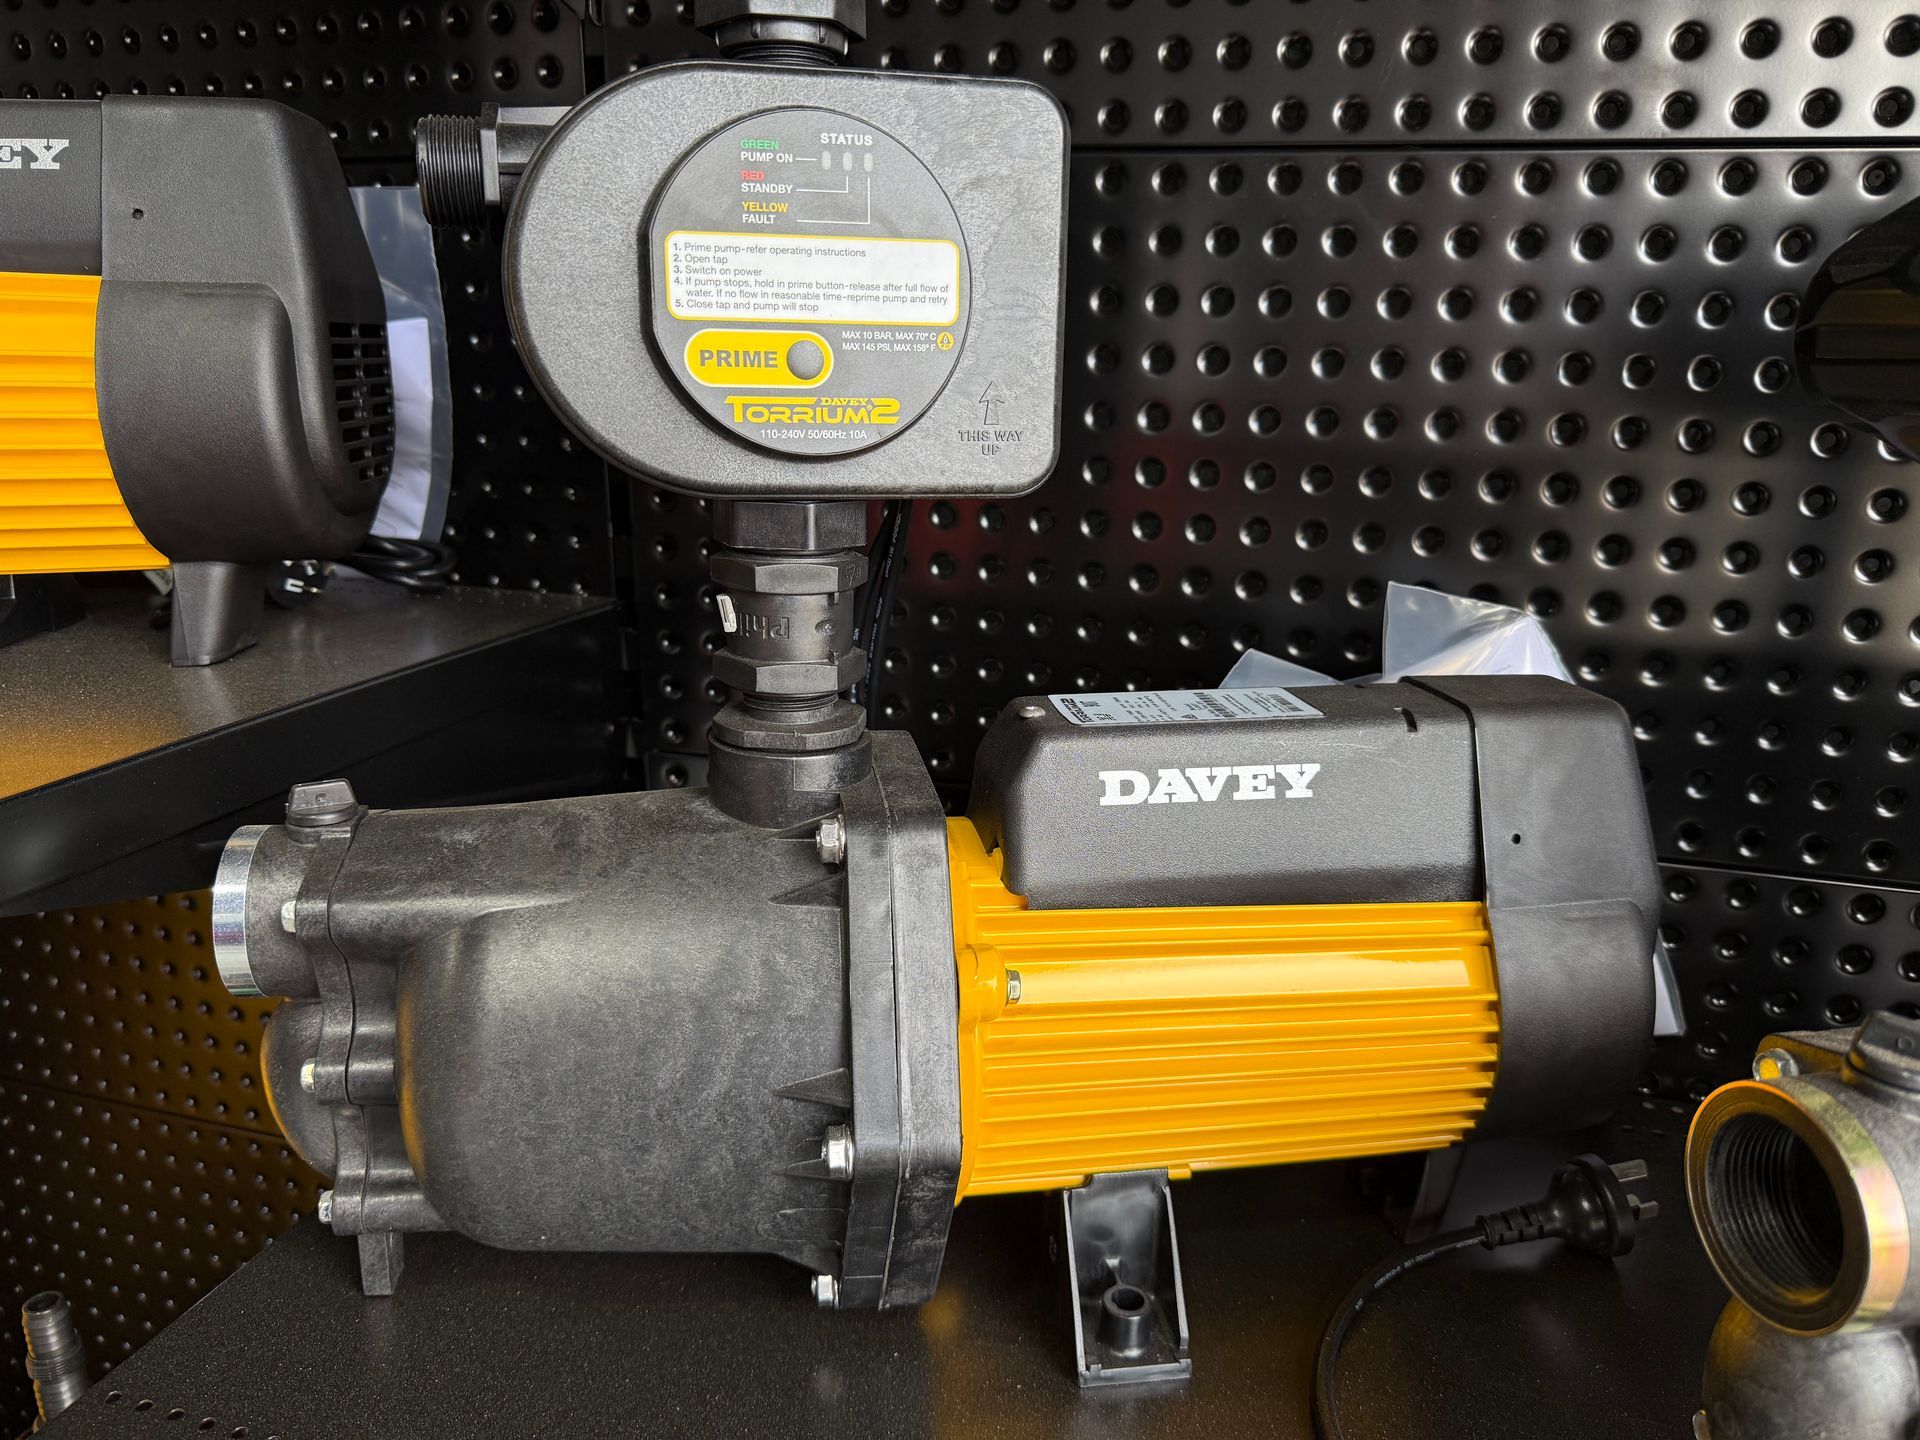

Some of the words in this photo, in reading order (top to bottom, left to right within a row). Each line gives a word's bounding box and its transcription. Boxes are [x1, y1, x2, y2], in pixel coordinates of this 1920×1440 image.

[740, 138, 779, 150] GREEN
[820, 132, 873, 146] STATUS
[740, 151, 774, 162] PUMP
[776, 153, 793, 163] ON
[741, 170, 765, 181] RED
[741, 183, 793, 194] STANDBY
[742, 201, 788, 213] YELLOW
[742, 214, 776, 224] FAULT
[673, 243, 681, 251] 1.
[684, 242, 711, 252] Prime
[714, 244, 767, 254] pump-refer
[769, 246, 812, 257] operating
[815, 247, 866, 258] instructions
[673, 254, 682, 263] 2.
[685, 254, 711, 264] Open
[713, 255, 728, 265] tap
[674, 265, 682, 274] 3.
[685, 265, 718, 275] Switch
[719, 267, 731, 275] on
[733, 268, 762, 277] power
[674, 277, 683, 285] 4.
[685, 277, 692, 285] If
[694, 278, 721, 287] pump
[724, 279, 752, 288] stops,
[754, 279, 774, 288] hold
[777, 280, 785, 288] in
[787, 280, 814, 290] prime
[815, 281, 880, 292] button-release
[883, 283, 903, 292] after
[905, 283, 918, 292] full
[920, 284, 938, 293] flow
[940, 284, 949, 293] of
[686, 288, 714, 298] water.
[716, 289, 723, 298] If
[725, 290, 737, 298] no
[739, 289, 758, 299] flow
[761, 290, 769, 299] in
[771, 291, 820, 301] reasonable
[823, 292, 880, 303] time-reprime
[883, 294, 908, 304] pump
[910, 294, 926, 303] and
[928, 296, 948, 306] retry
[675, 300, 684, 308] 5.
[686, 299, 714, 309] Close
[716, 301, 731, 310] tap
[733, 301, 750, 310] and
[753, 302, 779, 312] pump
[782, 302, 796, 311] will
[799, 303, 819, 312] stop
[842, 330, 861, 339] MAX
[863, 331, 873, 339] 10
[874, 331, 894, 341] BAR,
[895, 332, 914, 341] MAX
[930, 333, 937, 341] C
[842, 342, 861, 351] MAX
[862, 343, 875, 351] 145
[877, 343, 892, 352] PSI,
[893, 343, 911, 352] MAX
[930, 344, 936, 352] F
[699, 349, 779, 369] PRIME
[821, 397, 868, 406] DAVEY
[760, 429, 806, 439] 110-240V
[808, 430, 847, 439] 50/60Hz
[849, 430, 867, 439] 10A
[958, 430, 990, 442] THIS
[994, 430, 1024, 442] WAY
[981, 444, 1000, 456] UP
[1099, 763, 1321, 806] DAVEY
